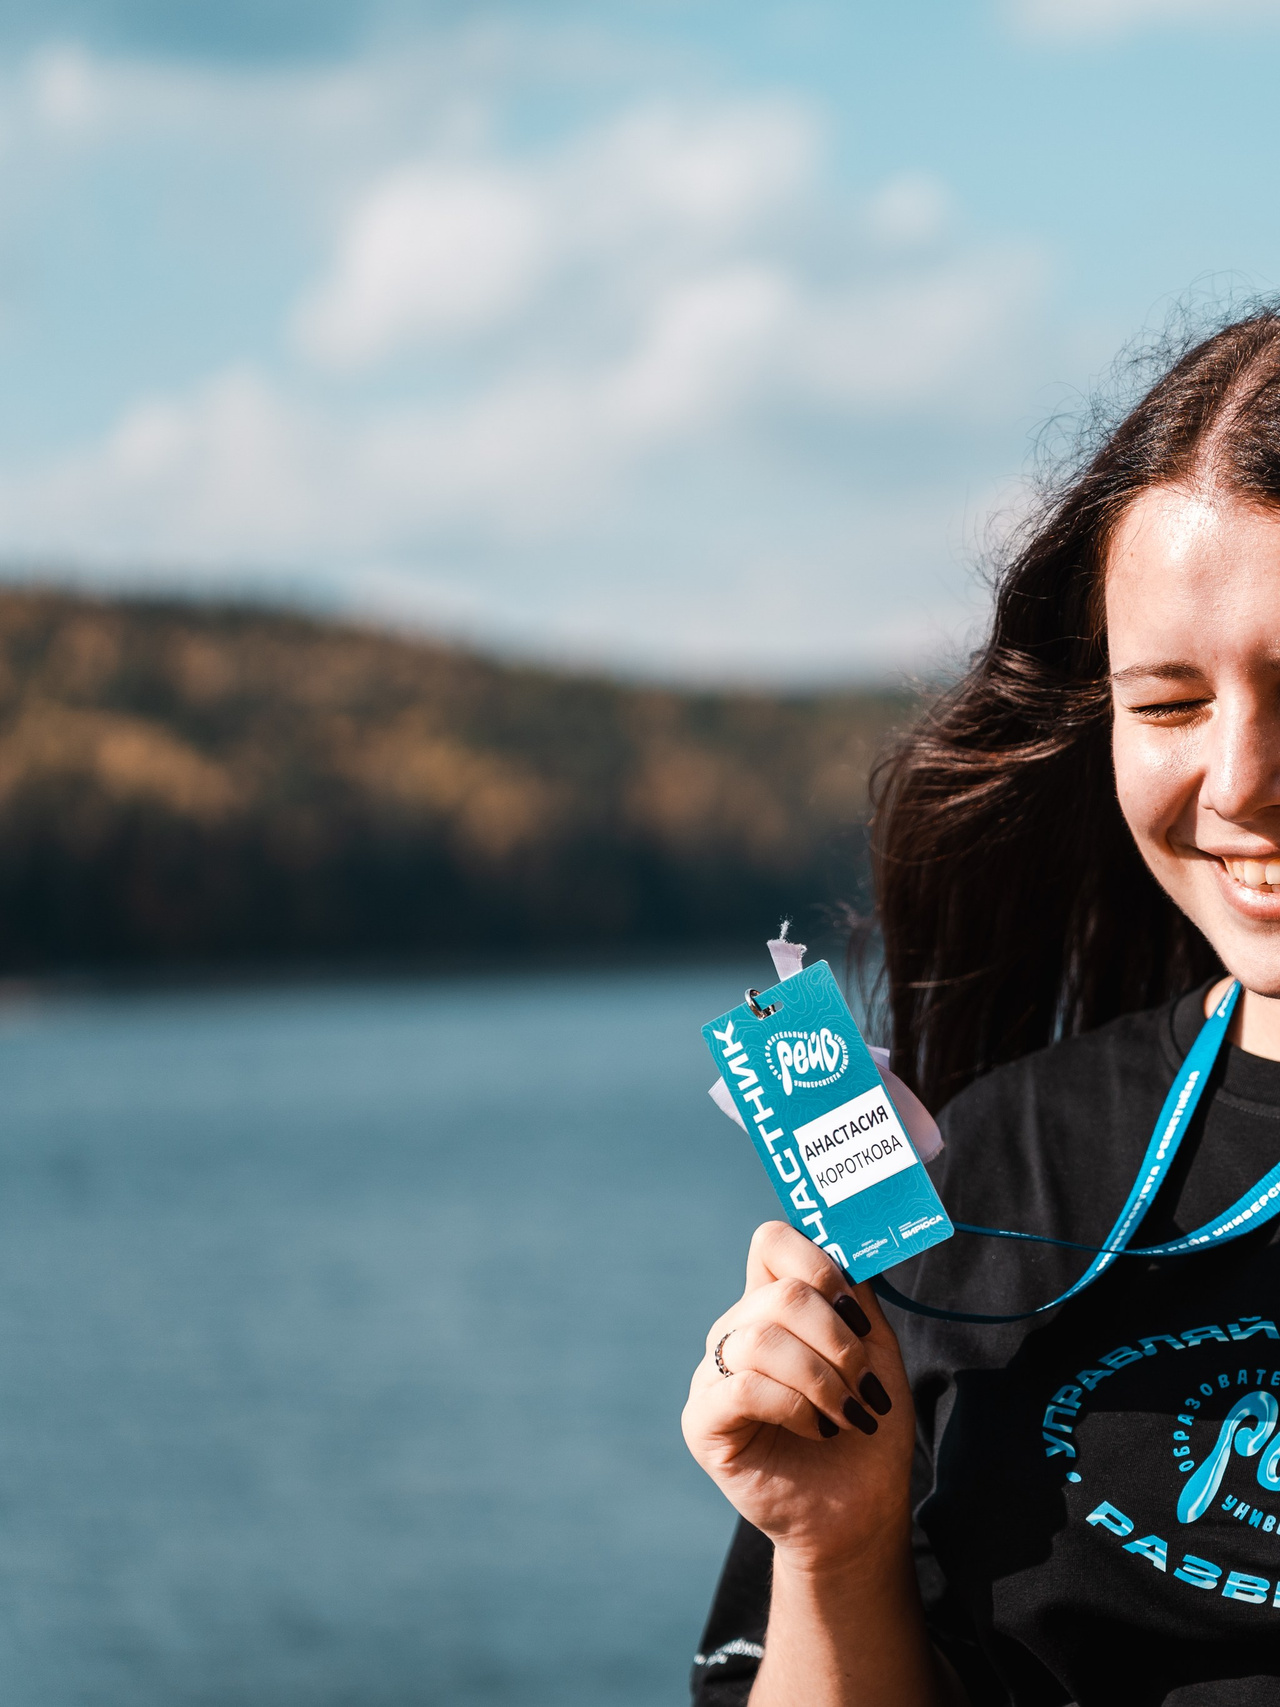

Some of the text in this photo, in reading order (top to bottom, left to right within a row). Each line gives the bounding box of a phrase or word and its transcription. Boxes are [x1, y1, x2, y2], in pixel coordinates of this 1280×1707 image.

[804, 1105, 889, 1162] АНАСТАСИЯ
[816, 1135, 903, 1189] КОРОТКОВА
[1042, 1315, 1280, 1459] УПРАВЛЯЙ
